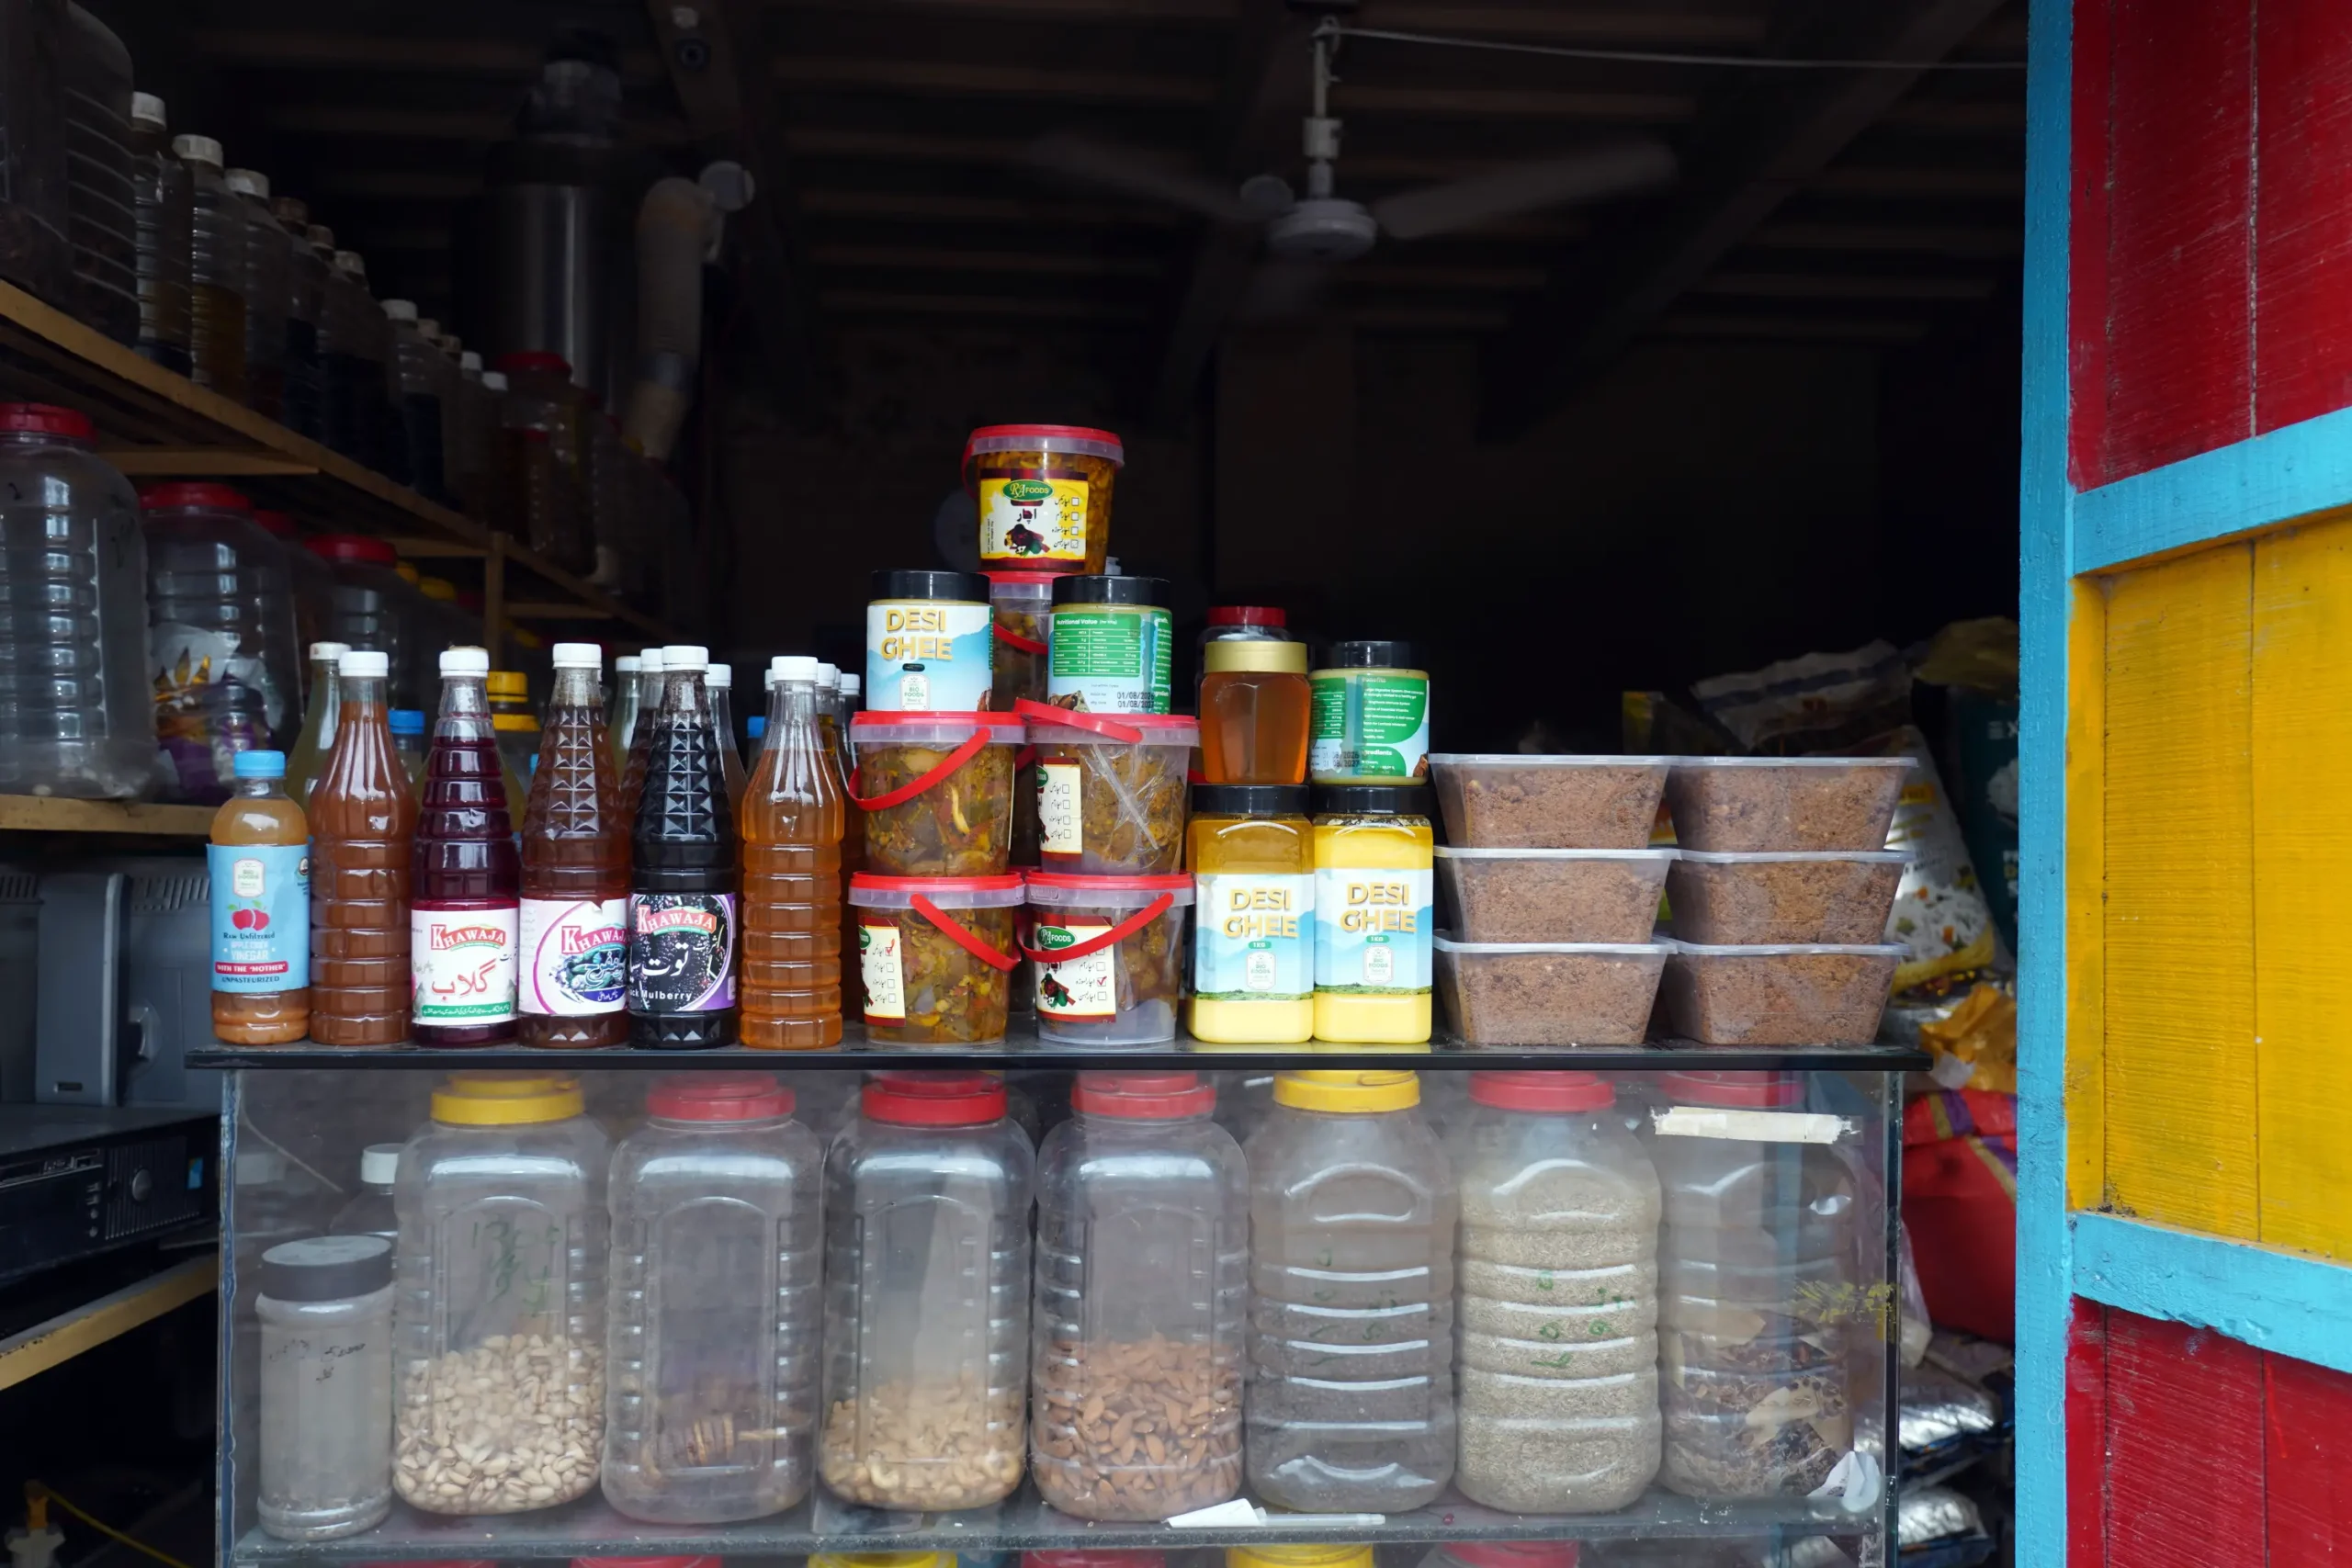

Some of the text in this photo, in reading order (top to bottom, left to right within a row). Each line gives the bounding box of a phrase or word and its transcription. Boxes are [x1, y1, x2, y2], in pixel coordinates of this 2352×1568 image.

[1016, 508, 1037, 525] اچار
[886, 608, 946, 633] DESI
[880, 637, 953, 661] GHEE
[1230, 887, 1291, 911] DESI
[1347, 882, 1409, 906] DESI
[638, 906, 713, 932] KHAWAJA
[1223, 915, 1299, 939] GHEE
[1340, 909, 1417, 933] GHEE
[431, 925, 504, 949] KHAWAJA
[561, 927, 627, 953] KHAWAJ
[1051, 934, 1071, 942] FOODS
[231, 950, 268, 961] VINEGAR
[641, 942, 689, 976] توت
[431, 958, 496, 1001] گلاب
[641, 989, 692, 1001] Mulberry
